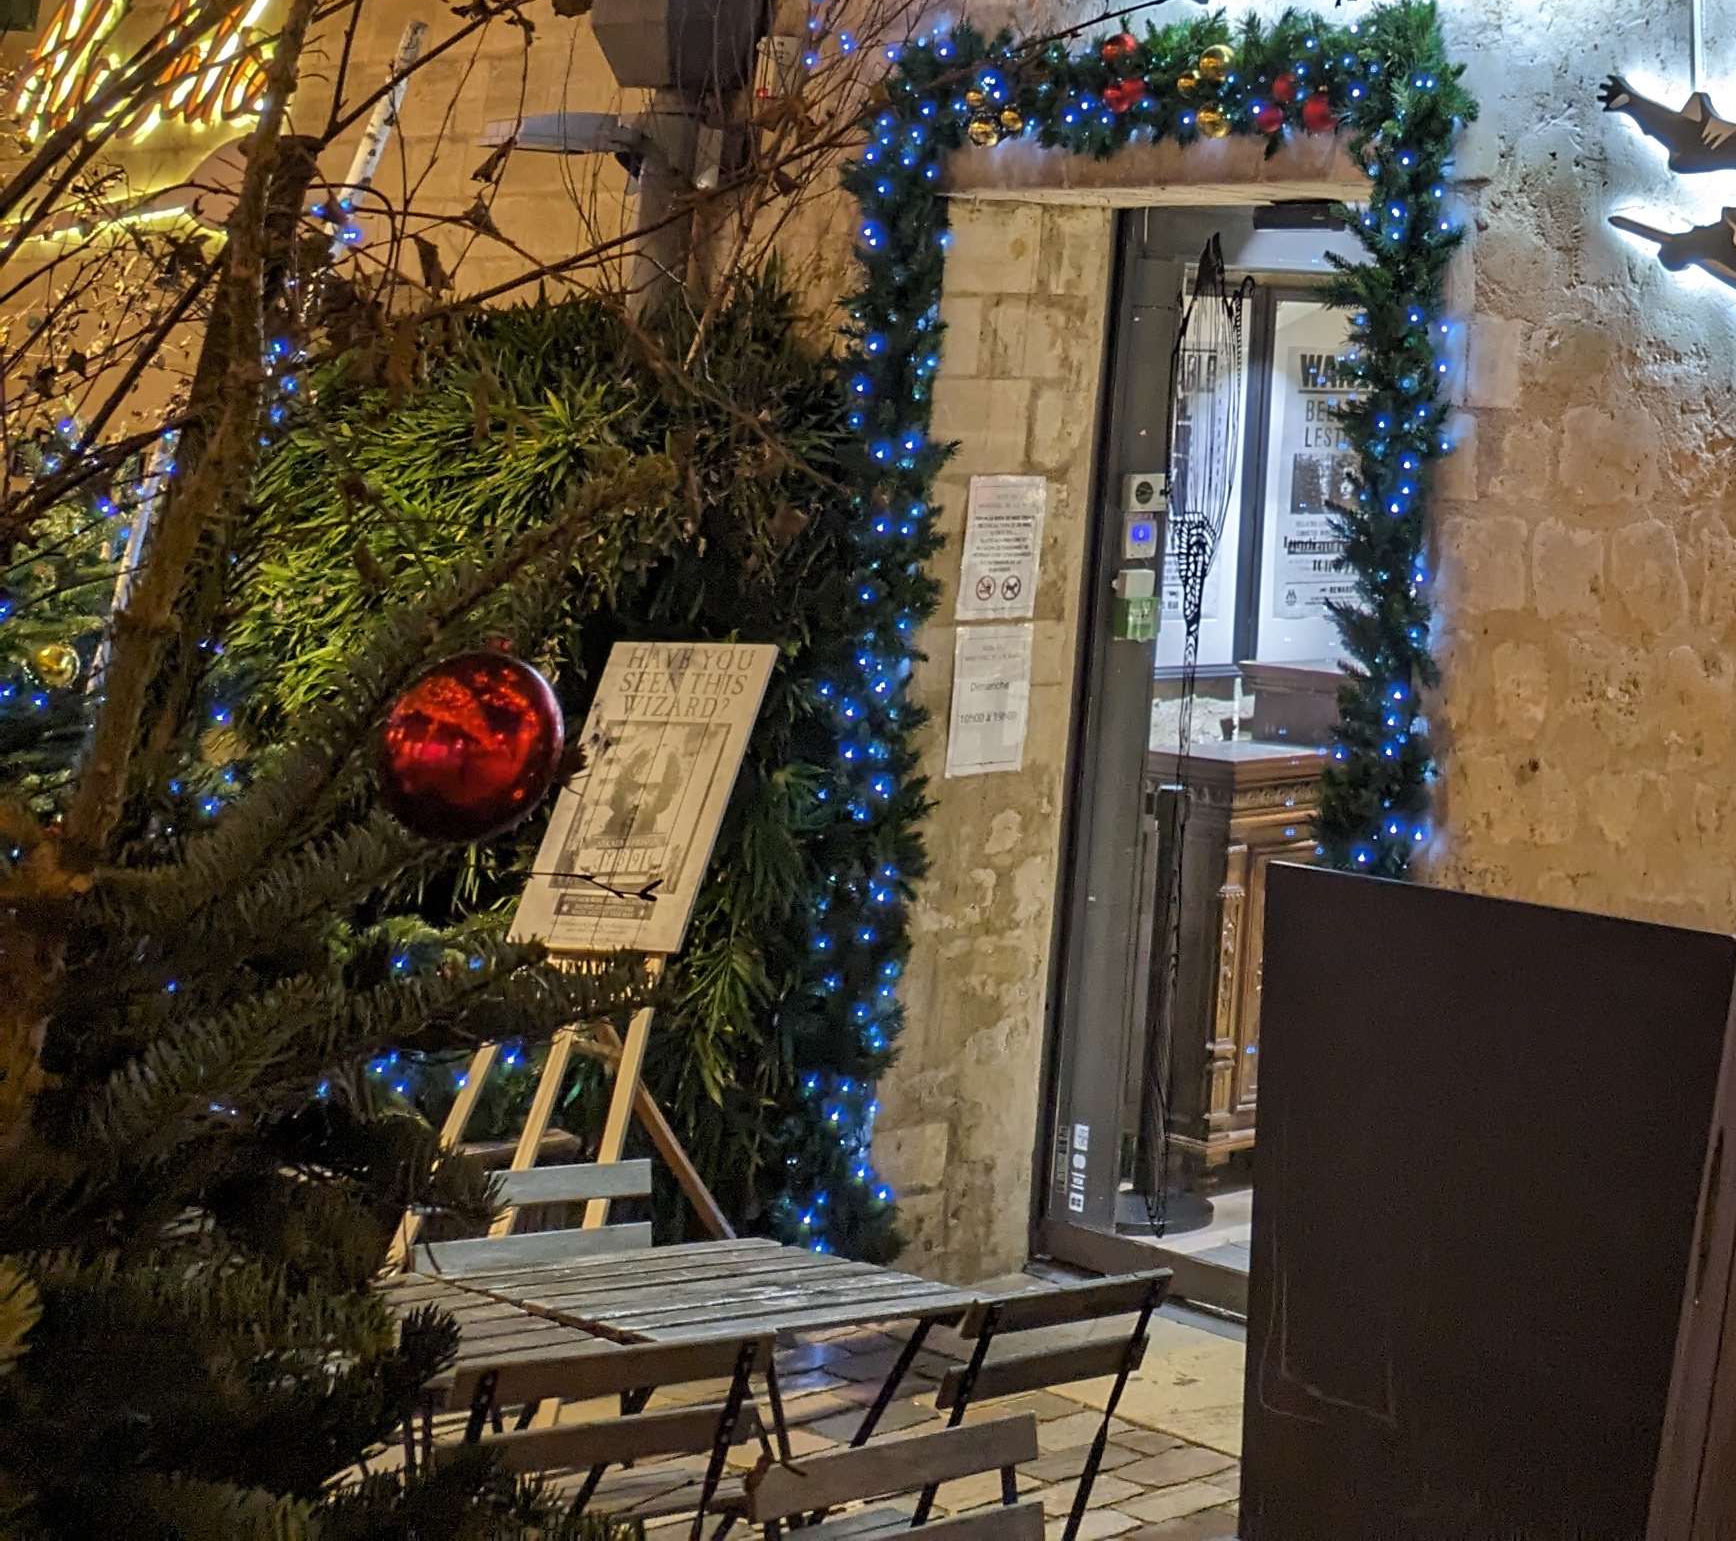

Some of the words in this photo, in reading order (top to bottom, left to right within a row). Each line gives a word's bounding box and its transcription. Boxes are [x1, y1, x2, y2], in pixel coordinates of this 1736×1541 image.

[627, 646, 694, 669] HAVE
[699, 648, 756, 671] YOU
[619, 671, 684, 693] SEEN
[690, 673, 748, 695] THIS
[622, 694, 731, 718] WIZARD?
